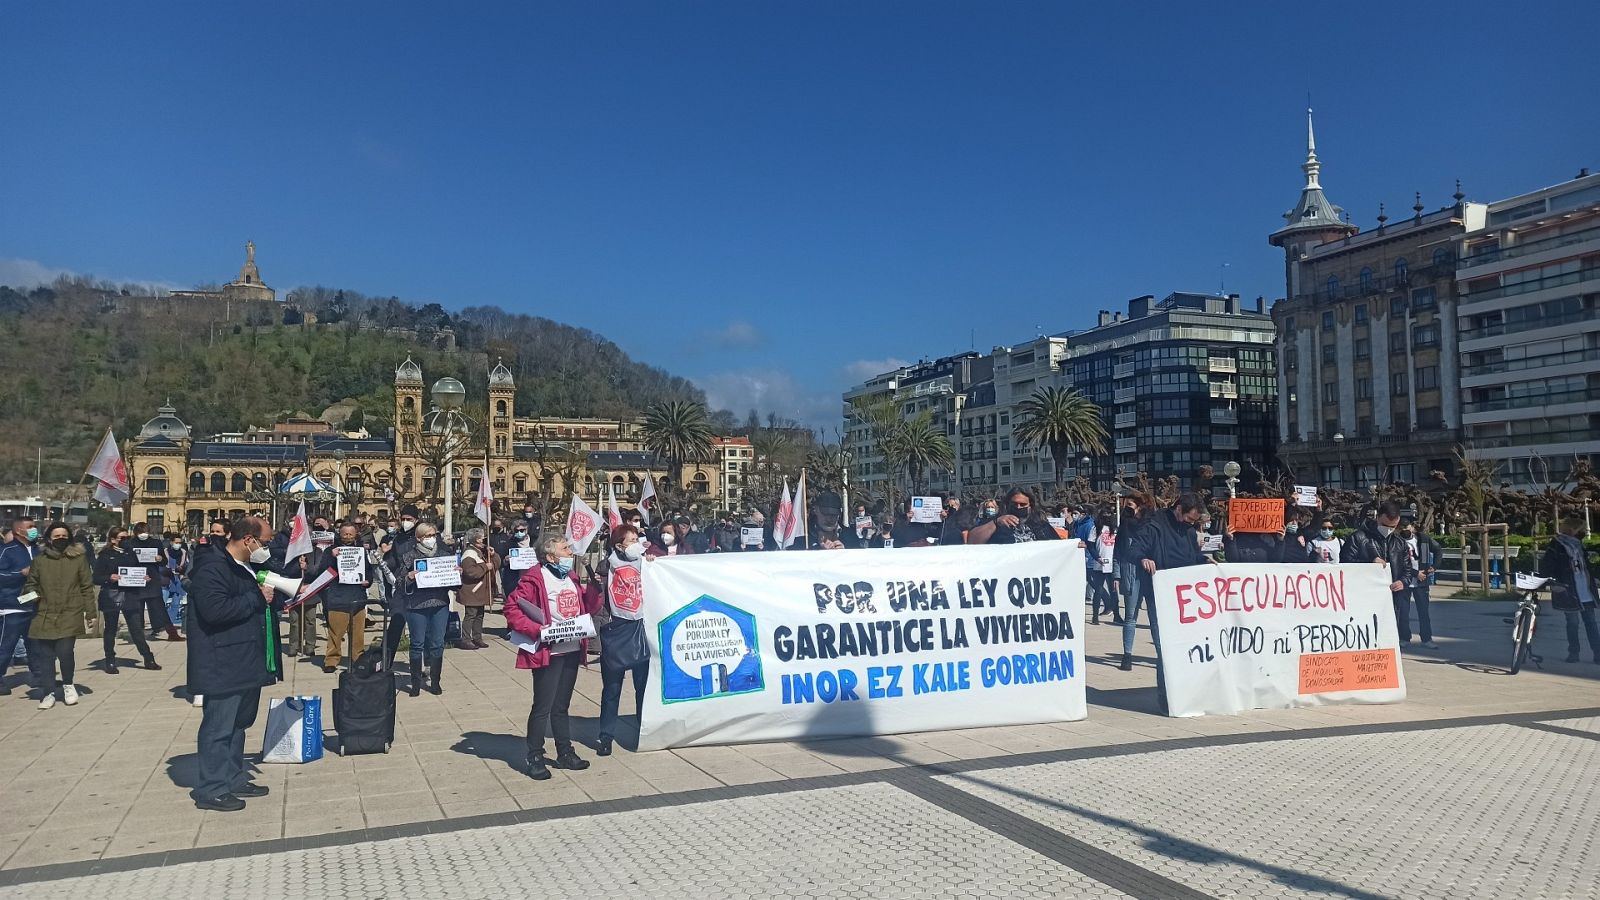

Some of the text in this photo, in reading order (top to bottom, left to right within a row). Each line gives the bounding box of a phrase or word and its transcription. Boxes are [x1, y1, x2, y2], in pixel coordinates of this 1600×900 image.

[813, 576, 1052, 613] POR UNA LEY QUE
[686, 617, 728, 630] INICIATIVA
[686, 629, 731, 642] POR UNA LEY
[774, 612, 1074, 662] GARANTICE LA VIVIENDA
[1189, 637, 1214, 663] ni
[1220, 626, 1264, 659] OVIDO
[1274, 632, 1292, 654] ni
[685, 647, 741, 662] A LA VIVIENDA
[782, 650, 1074, 704] INOR EZ KALE GORRIAN
[305, 705, 315, 725] Care
[305, 725, 314, 735] of
